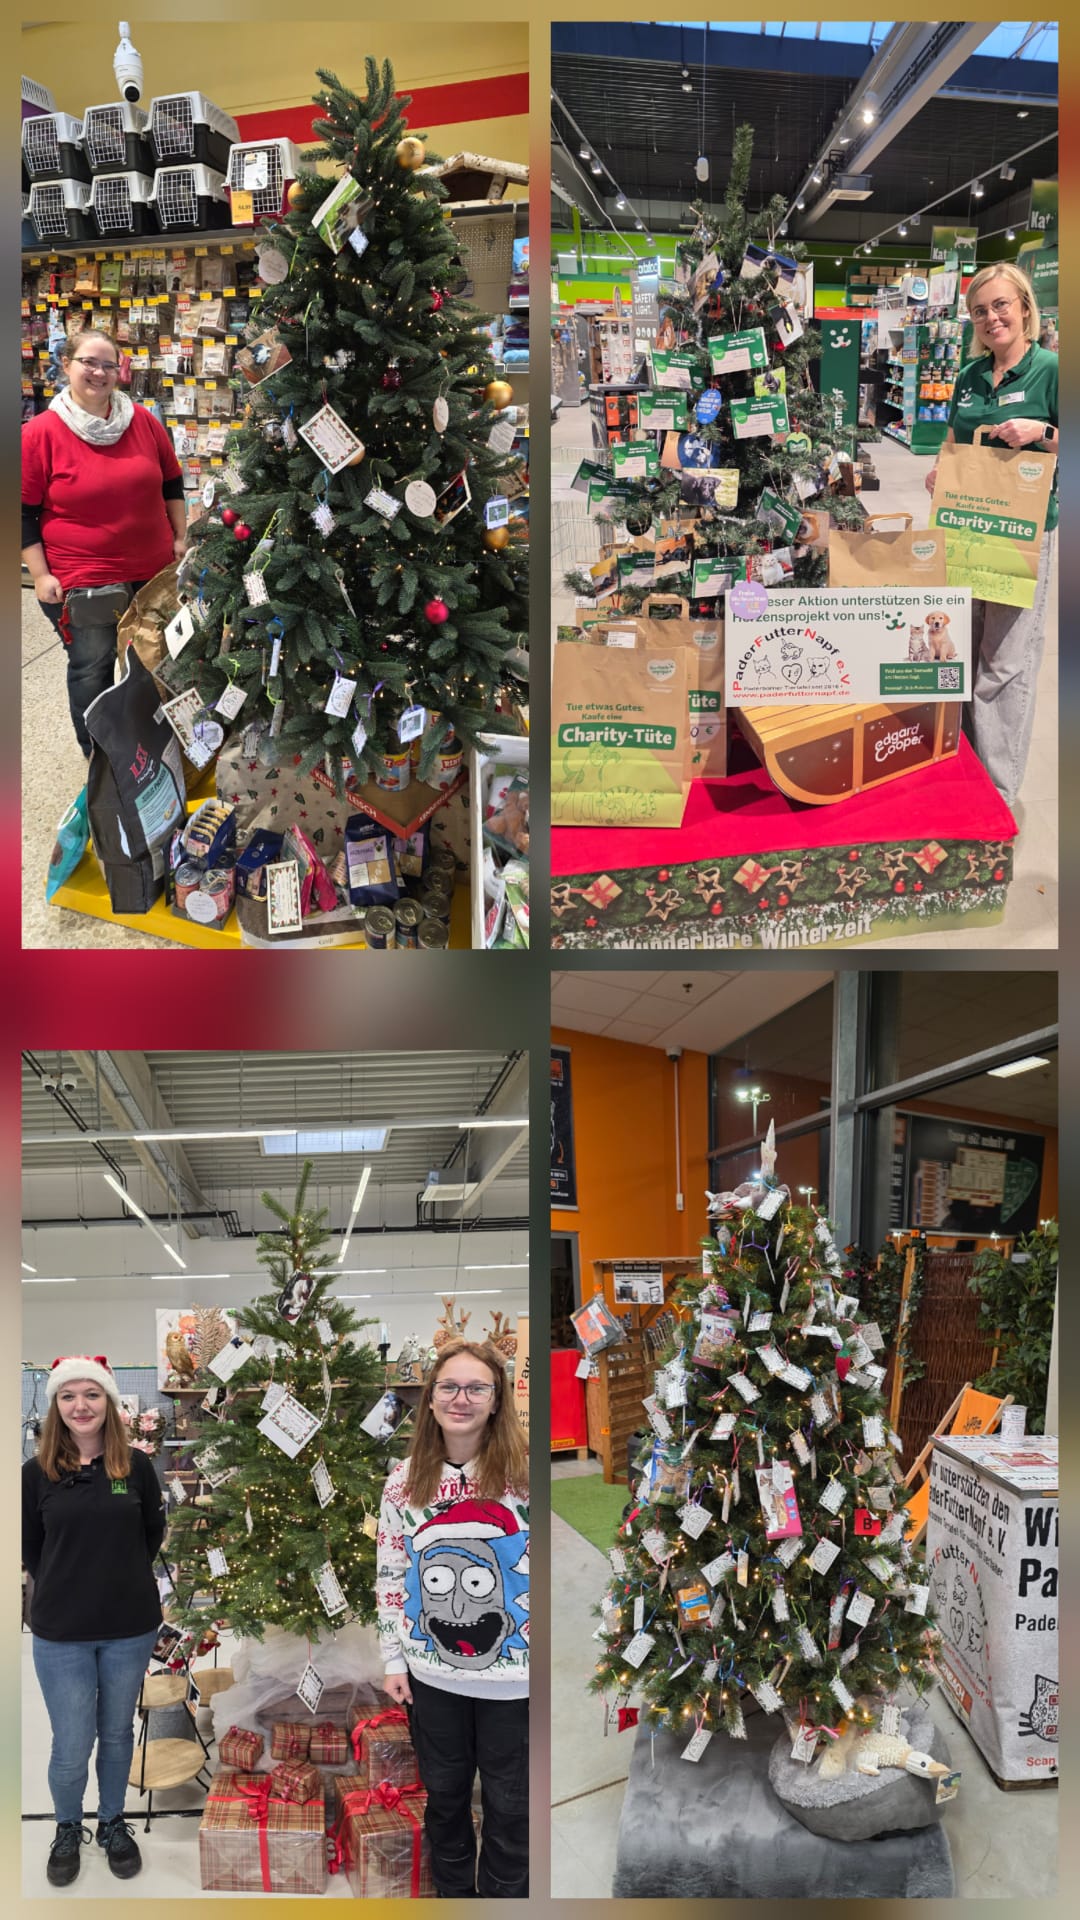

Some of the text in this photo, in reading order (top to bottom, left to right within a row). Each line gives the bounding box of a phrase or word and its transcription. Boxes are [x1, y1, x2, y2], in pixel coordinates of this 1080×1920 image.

[634, 293, 656, 304] SAFETY
[959, 494, 983, 503] etwas
[940, 512, 1033, 537] Charity-Tüte
[798, 596, 838, 606] Aktion
[841, 595, 920, 606] unterstützen
[923, 595, 943, 605] Sie
[946, 594, 965, 605] ein
[832, 613, 855, 621] von
[858, 610, 885, 621] uns!
[566, 703, 645, 712] Tue etwas Gutes:
[581, 713, 605, 721] Kaufe
[562, 726, 673, 747] Charity-Tüte
[875, 723, 920, 752] edgard
[875, 735, 925, 762] Cooper
[614, 912, 873, 949] Wunderbare Winterzeit
[940, 1464, 991, 1512] unterstützen
[991, 1492, 1010, 1526] den
[863, 1517, 873, 1531] B
[1018, 1558, 1058, 1598] Pa
[1015, 1613, 1058, 1632] Pade
[1026, 1756, 1057, 1767] Scan
